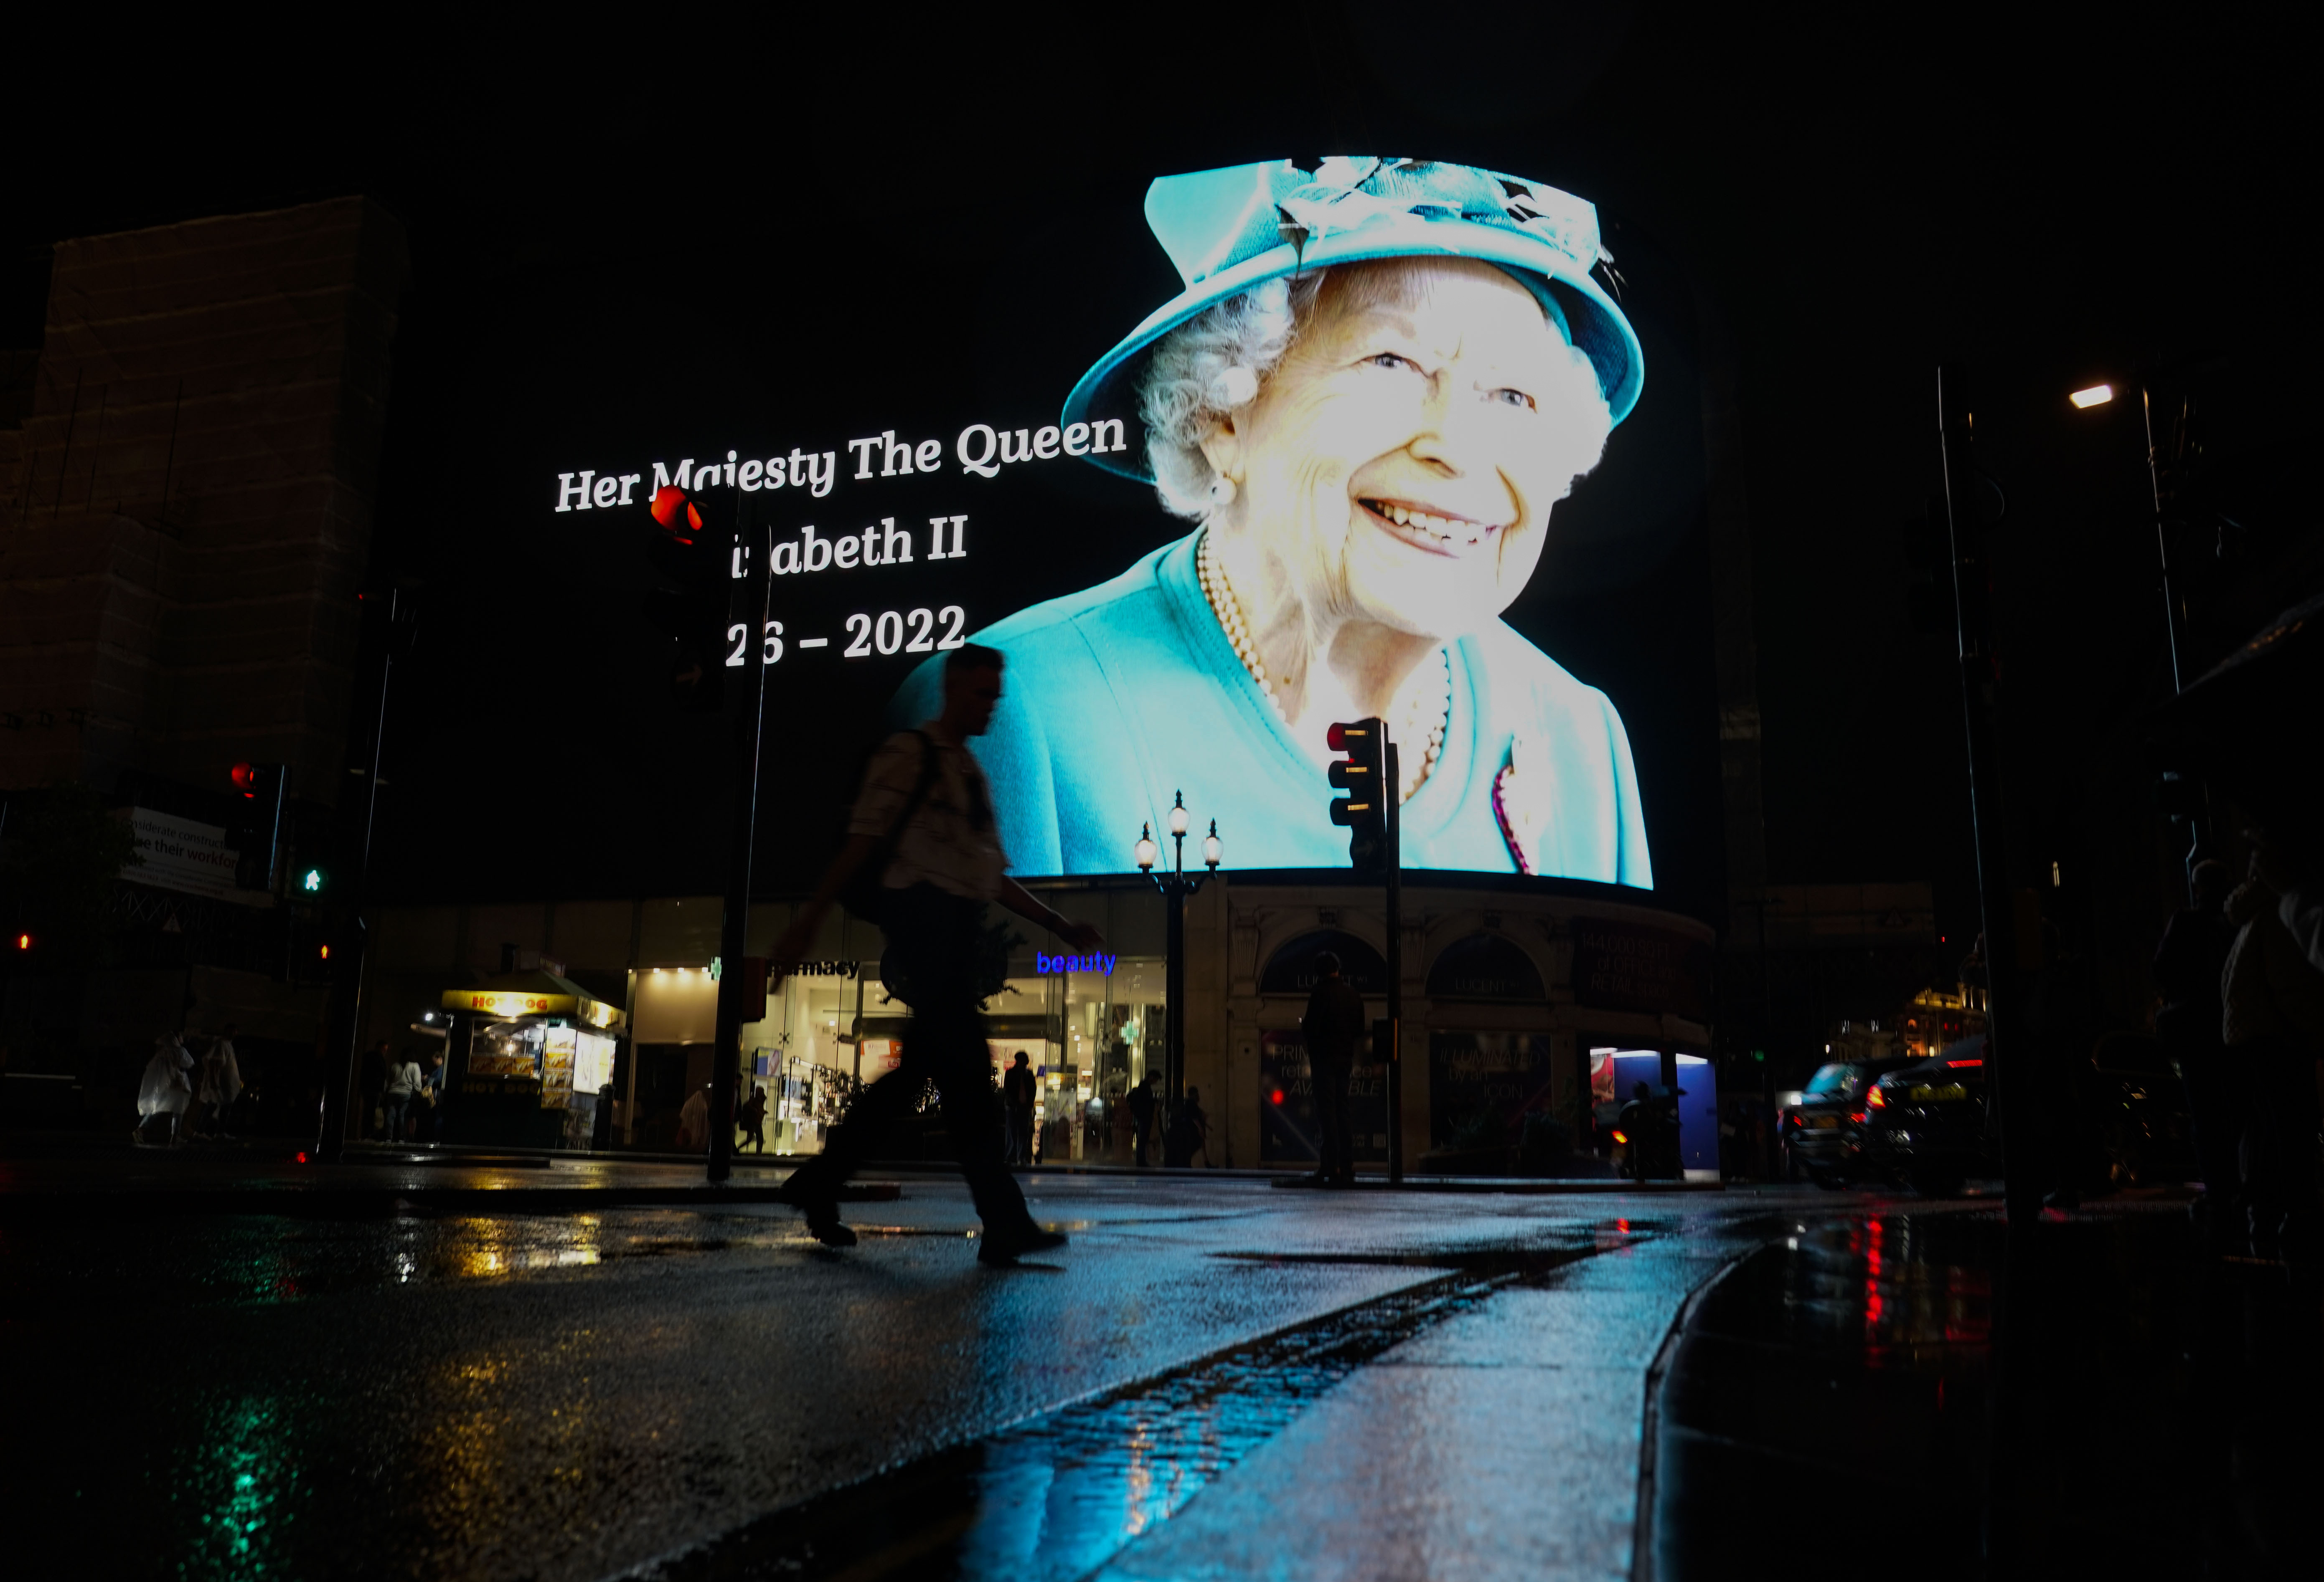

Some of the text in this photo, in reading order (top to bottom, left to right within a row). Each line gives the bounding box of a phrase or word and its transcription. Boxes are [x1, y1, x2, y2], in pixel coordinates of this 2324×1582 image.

[555, 470, 640, 512] Her
[848, 430, 941, 479] The
[957, 419, 1127, 478] Queen
[732, 515, 968, 578] iabeth II
[726, 621, 784, 667] 26
[844, 606, 965, 657] 2022
[127, 818, 227, 849] nsiderate construct
[155, 838, 184, 857] their
[188, 849, 238, 869] workfor
[1036, 950, 1116, 976] beauty
